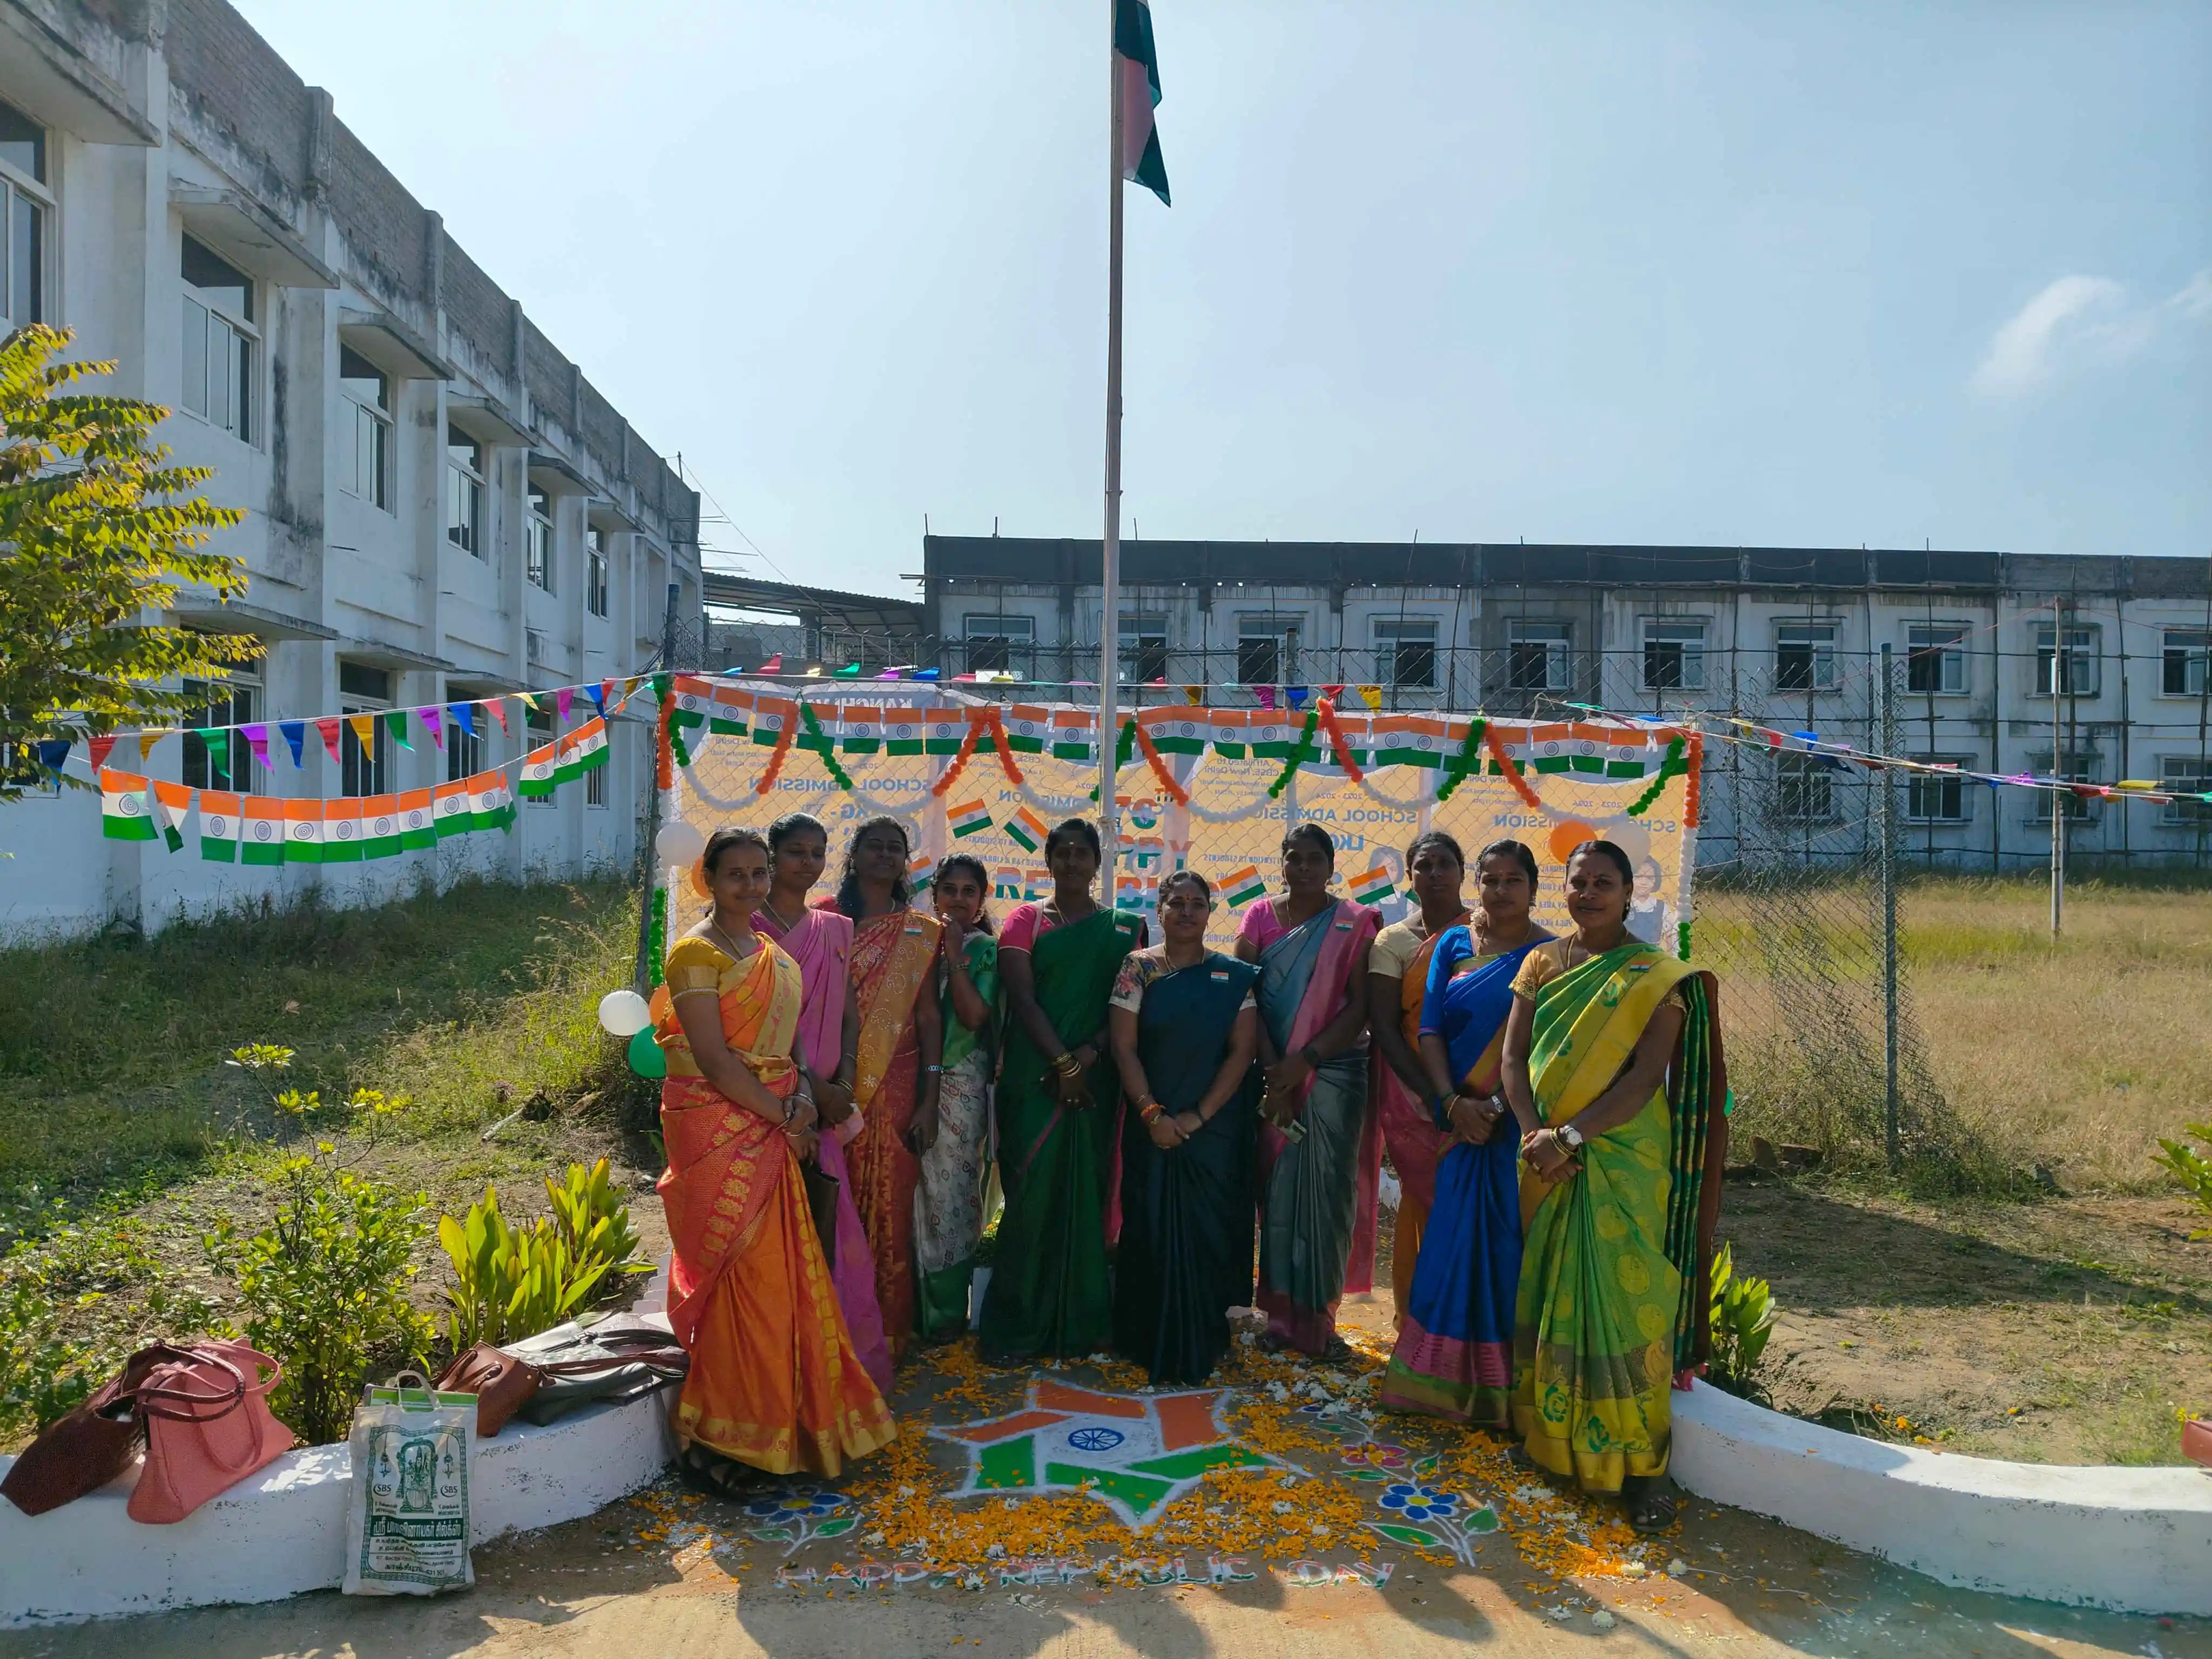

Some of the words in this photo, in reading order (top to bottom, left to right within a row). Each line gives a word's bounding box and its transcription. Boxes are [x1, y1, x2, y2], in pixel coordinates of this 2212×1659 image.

[377, 1484, 392, 1492] SBS
[444, 1485, 458, 1493] SBS
[1286, 1559, 1396, 1588] DAY
